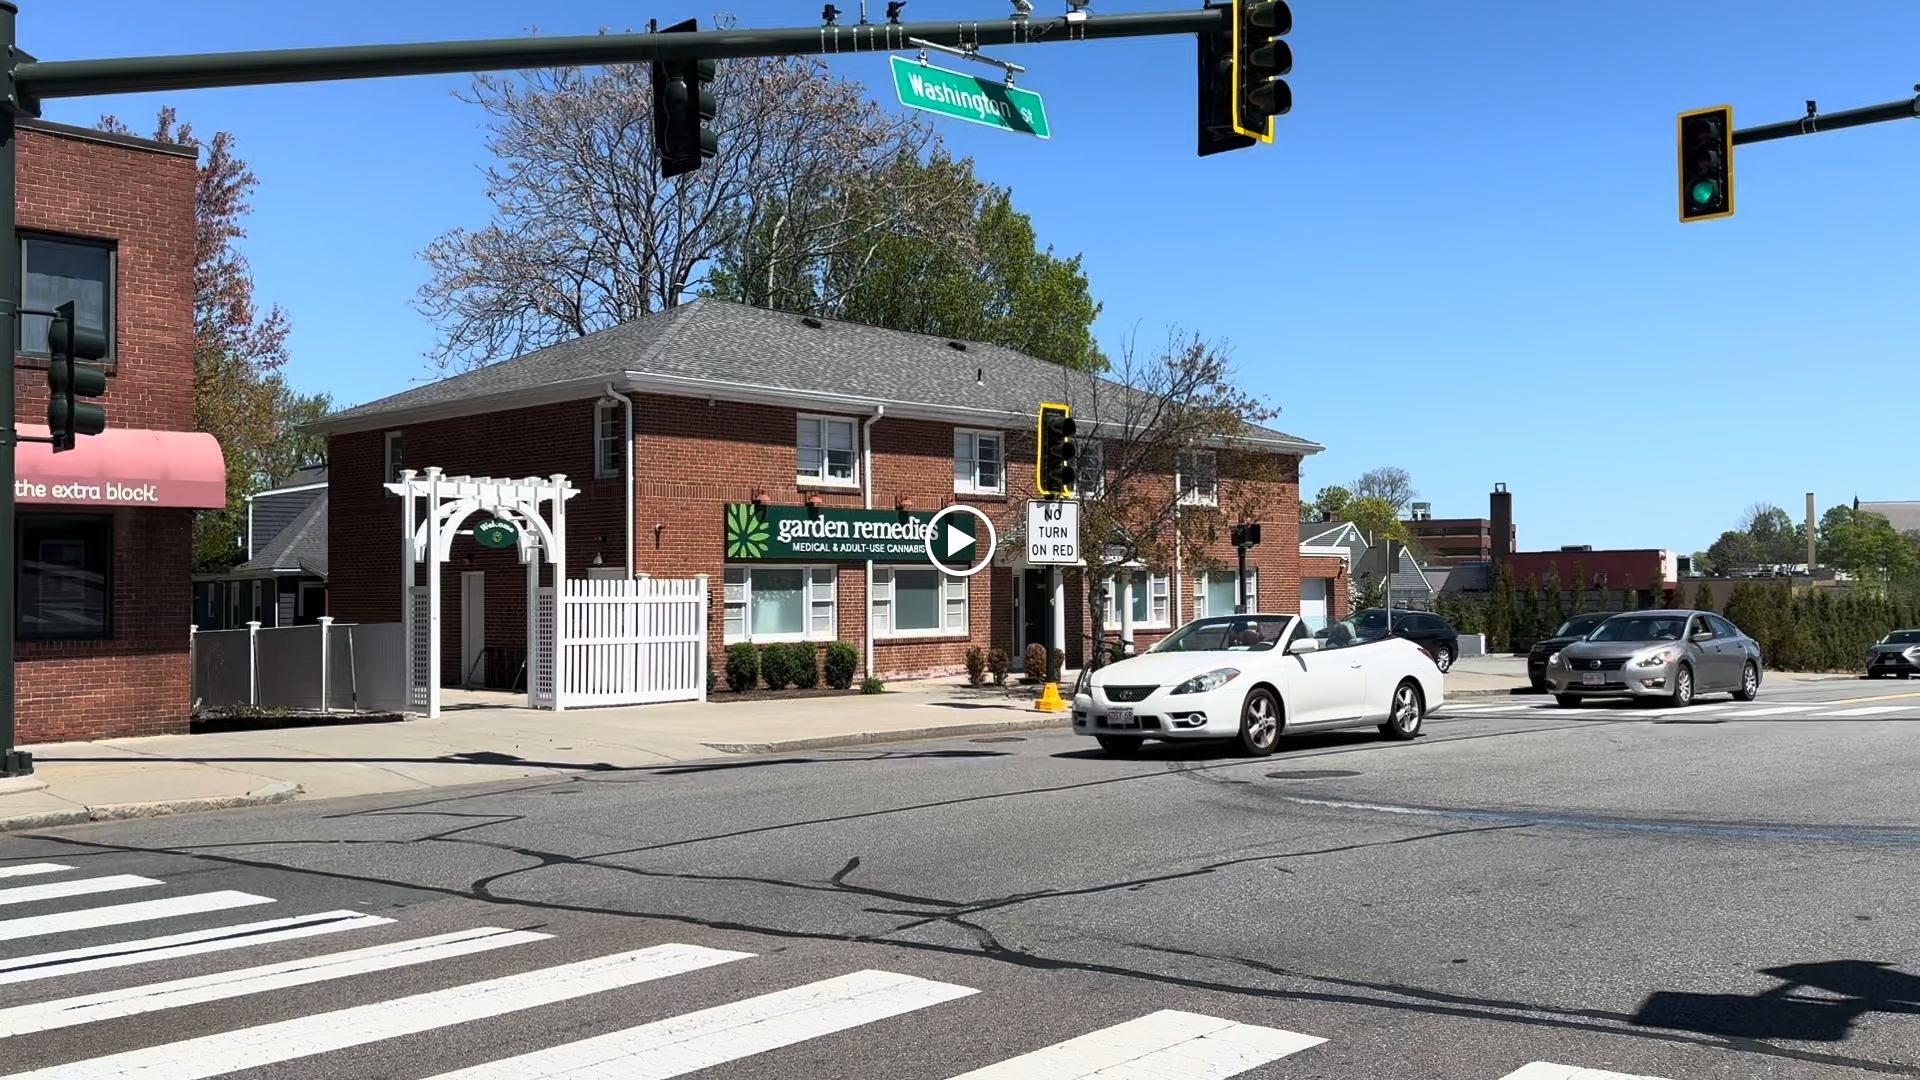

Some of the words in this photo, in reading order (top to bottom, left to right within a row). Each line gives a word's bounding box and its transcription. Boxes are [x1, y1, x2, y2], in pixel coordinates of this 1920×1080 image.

[908, 73, 1012, 119] Washington
[14, 479, 47, 498] the
[51, 482, 101, 500] extra
[1044, 508, 1062, 521] NO
[479, 520, 515, 533] Welcome
[777, 514, 850, 543] garden
[852, 515, 939, 541] remedies
[1038, 526, 1068, 539] TURN
[792, 542, 831, 552] MEDICAL
[832, 543, 839, 552] &
[840, 543, 885, 553] ADULT-USE
[886, 543, 927, 554] CANNABIS
[1031, 543, 1047, 556] ON
[1052, 544, 1074, 556] RED
